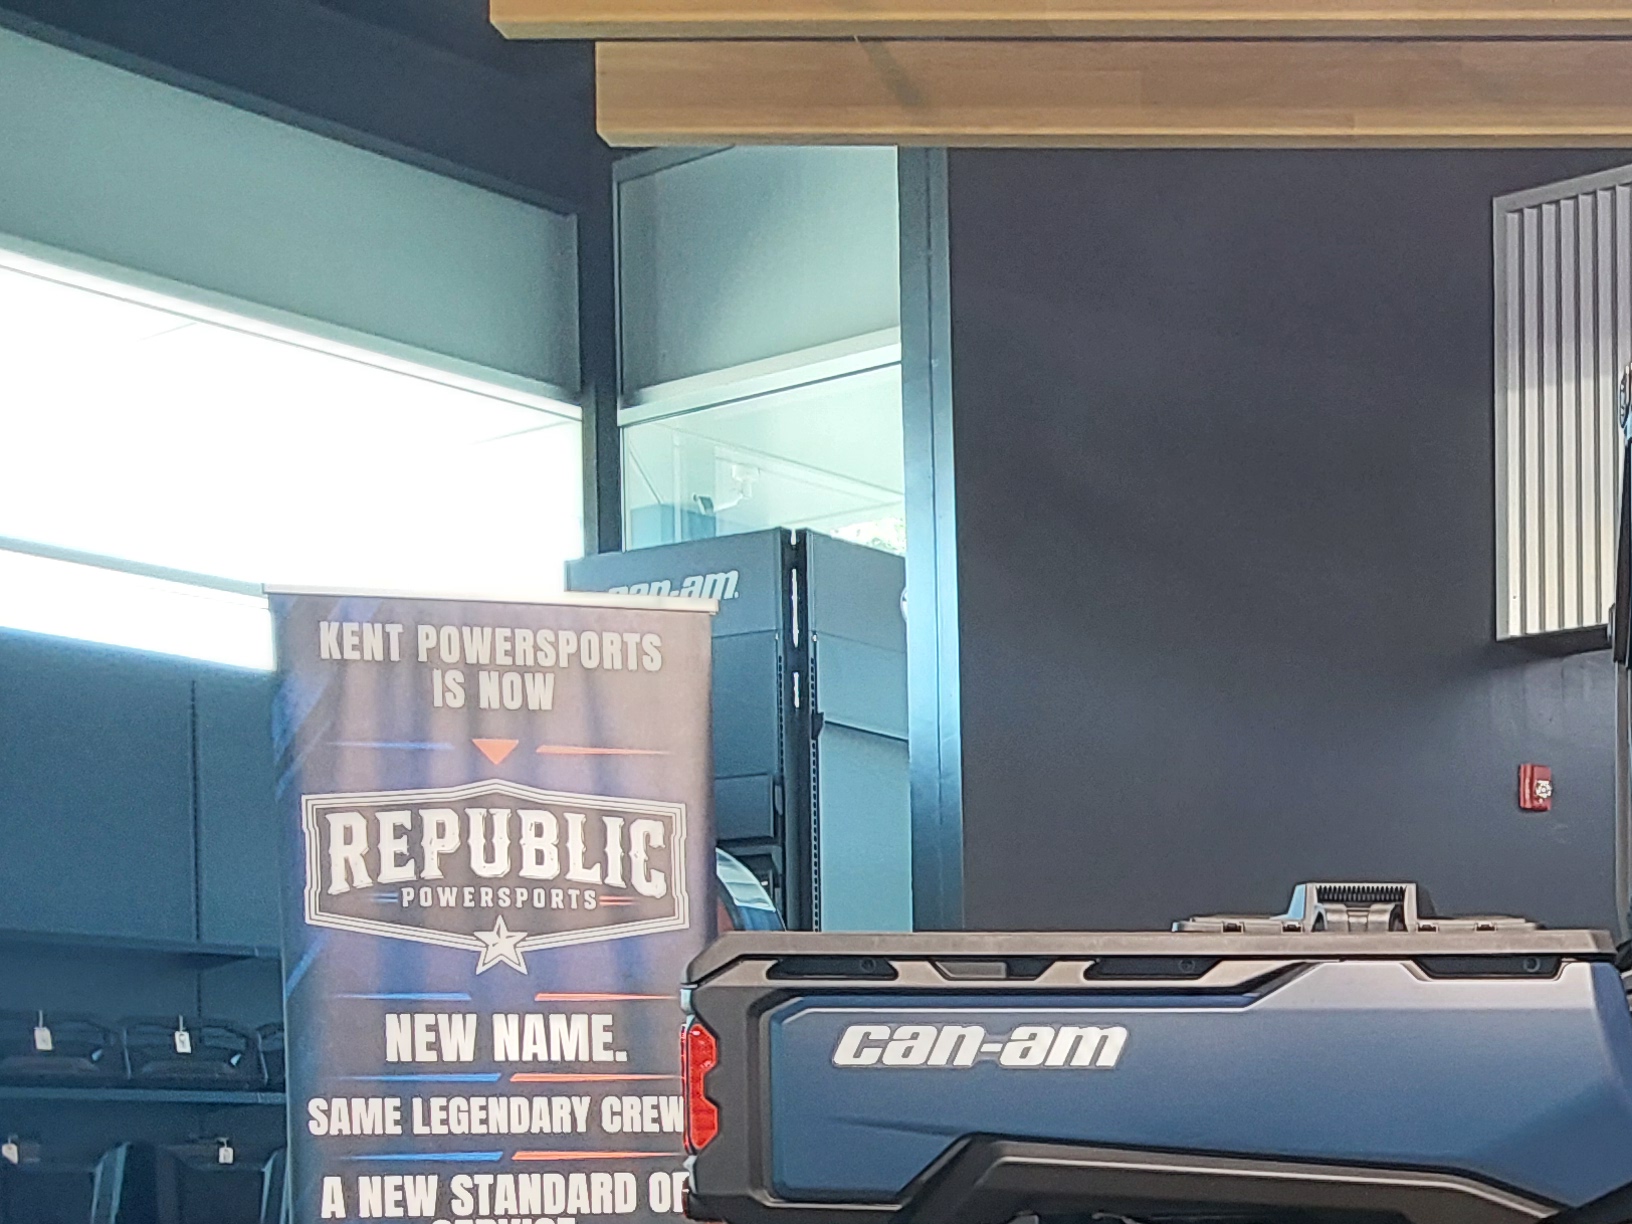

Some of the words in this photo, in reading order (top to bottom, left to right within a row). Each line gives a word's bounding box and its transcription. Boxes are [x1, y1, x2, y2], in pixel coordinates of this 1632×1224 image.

[319, 621, 403, 661] KENT
[417, 624, 663, 672] POWERSPORTS
[433, 668, 465, 708] IS
[478, 670, 555, 710] NOW
[325, 808, 667, 899] REPUBLIC
[401, 886, 597, 910] POWERSPORTS
[385, 1013, 477, 1062] NEW
[491, 1013, 628, 1062] NAME.
[833, 1025, 1129, 1067] can-am
[307, 1097, 402, 1136] SAME
[412, 1096, 591, 1135] LEGENDARY
[321, 1175, 346, 1219] A
[358, 1175, 438, 1218] NEW
[450, 1172, 637, 1217] STANDARD
